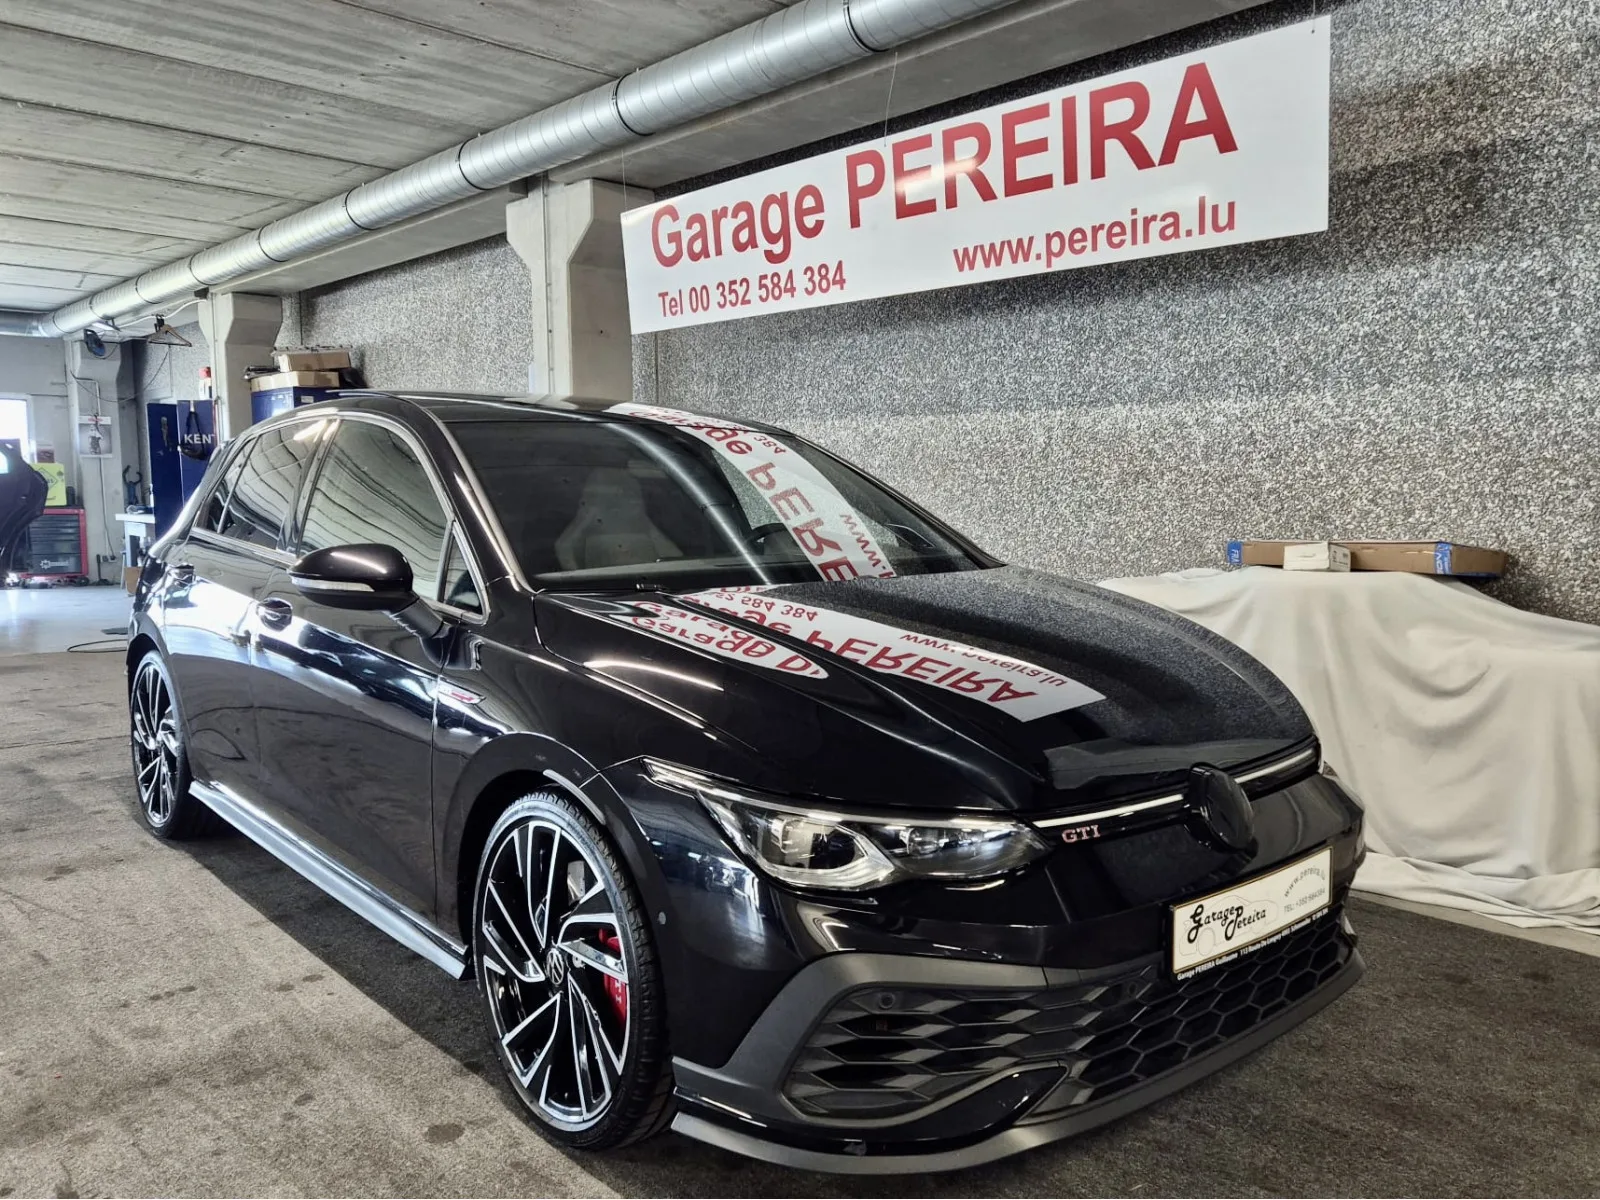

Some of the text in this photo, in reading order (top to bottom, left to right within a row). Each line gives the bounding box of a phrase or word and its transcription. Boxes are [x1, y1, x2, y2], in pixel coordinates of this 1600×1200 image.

[652, 62, 1239, 268] Garage PEREIRA
[953, 196, 1236, 272] www.pereira.lu
[658, 259, 847, 318] Tel 00 352 584 384
[1062, 825, 1101, 844] GTI
[1187, 904, 1236, 944] Garage
[1225, 905, 1266, 941] Pereira
